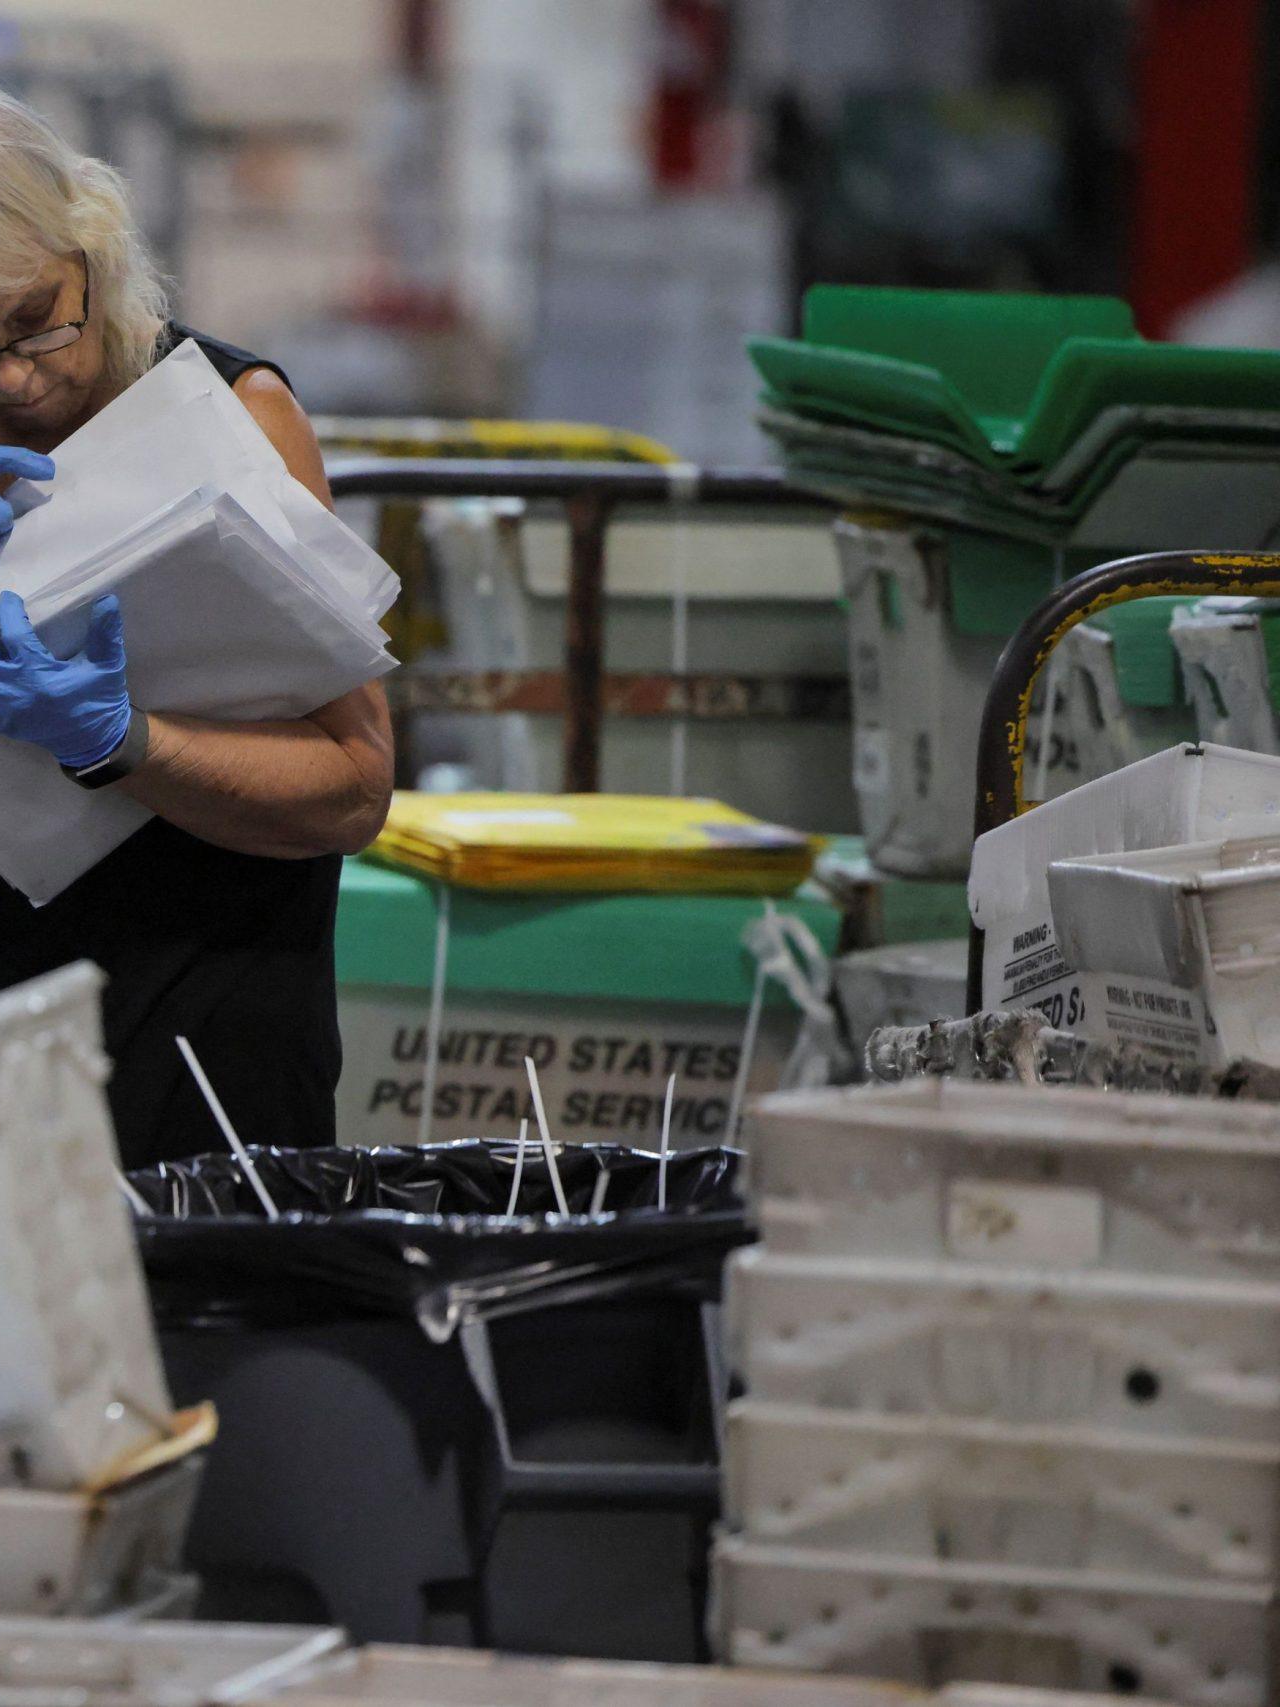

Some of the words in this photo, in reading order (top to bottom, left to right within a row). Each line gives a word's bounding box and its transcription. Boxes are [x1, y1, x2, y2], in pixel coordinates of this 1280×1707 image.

[1012, 923, 1048, 954] WARNING
[391, 1026, 558, 1071] UNITED
[568, 1036, 741, 1082] STATES
[368, 1080, 540, 1125] POSTA
[561, 1089, 743, 1136] SERVIC
